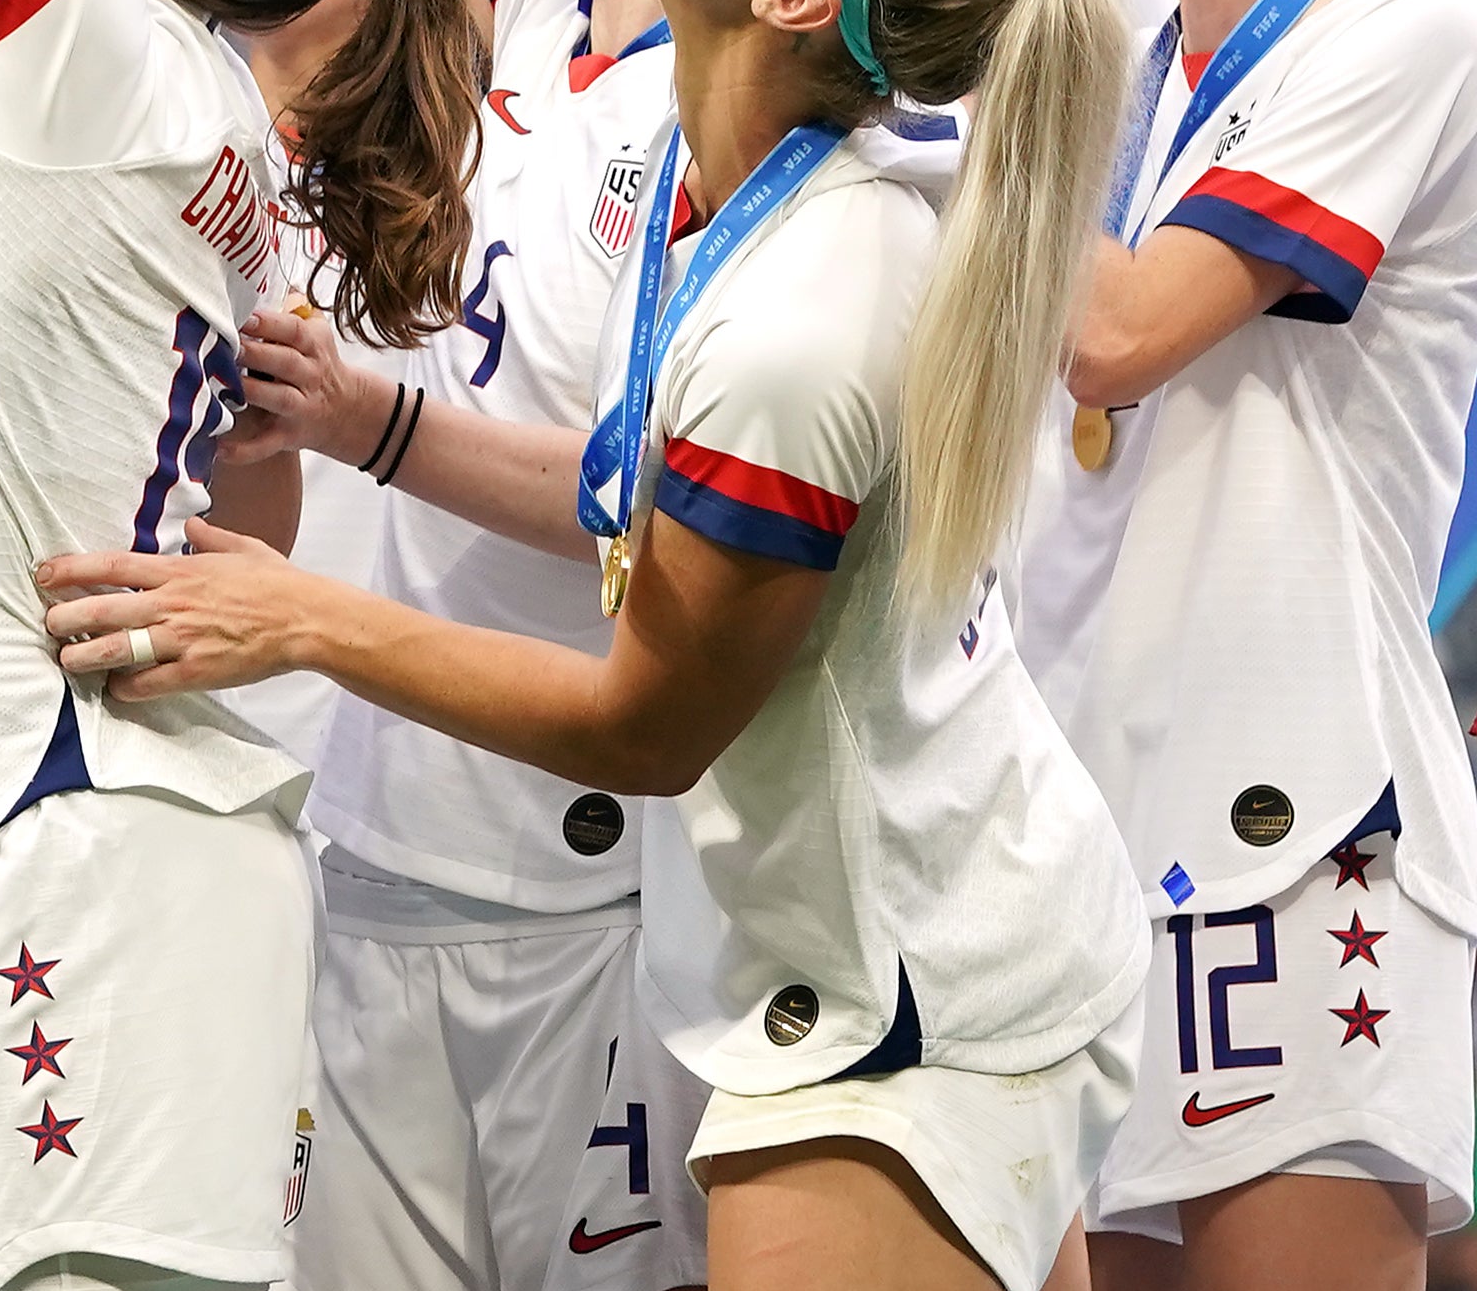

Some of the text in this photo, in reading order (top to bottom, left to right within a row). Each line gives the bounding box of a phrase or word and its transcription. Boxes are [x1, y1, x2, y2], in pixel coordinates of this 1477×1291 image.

[1252, 5, 1280, 40] FIFA
[1216, 49, 1244, 80] FIFA
[782, 142, 813, 175] FIFA
[608, 166, 644, 204] US
[741, 184, 773, 217] FIFA
[706, 227, 733, 262] FIFA
[679, 273, 700, 308] FIFA
[605, 425, 623, 458] IFA
[1166, 906, 1284, 1075] 12
[586, 1035, 650, 1195] 4
